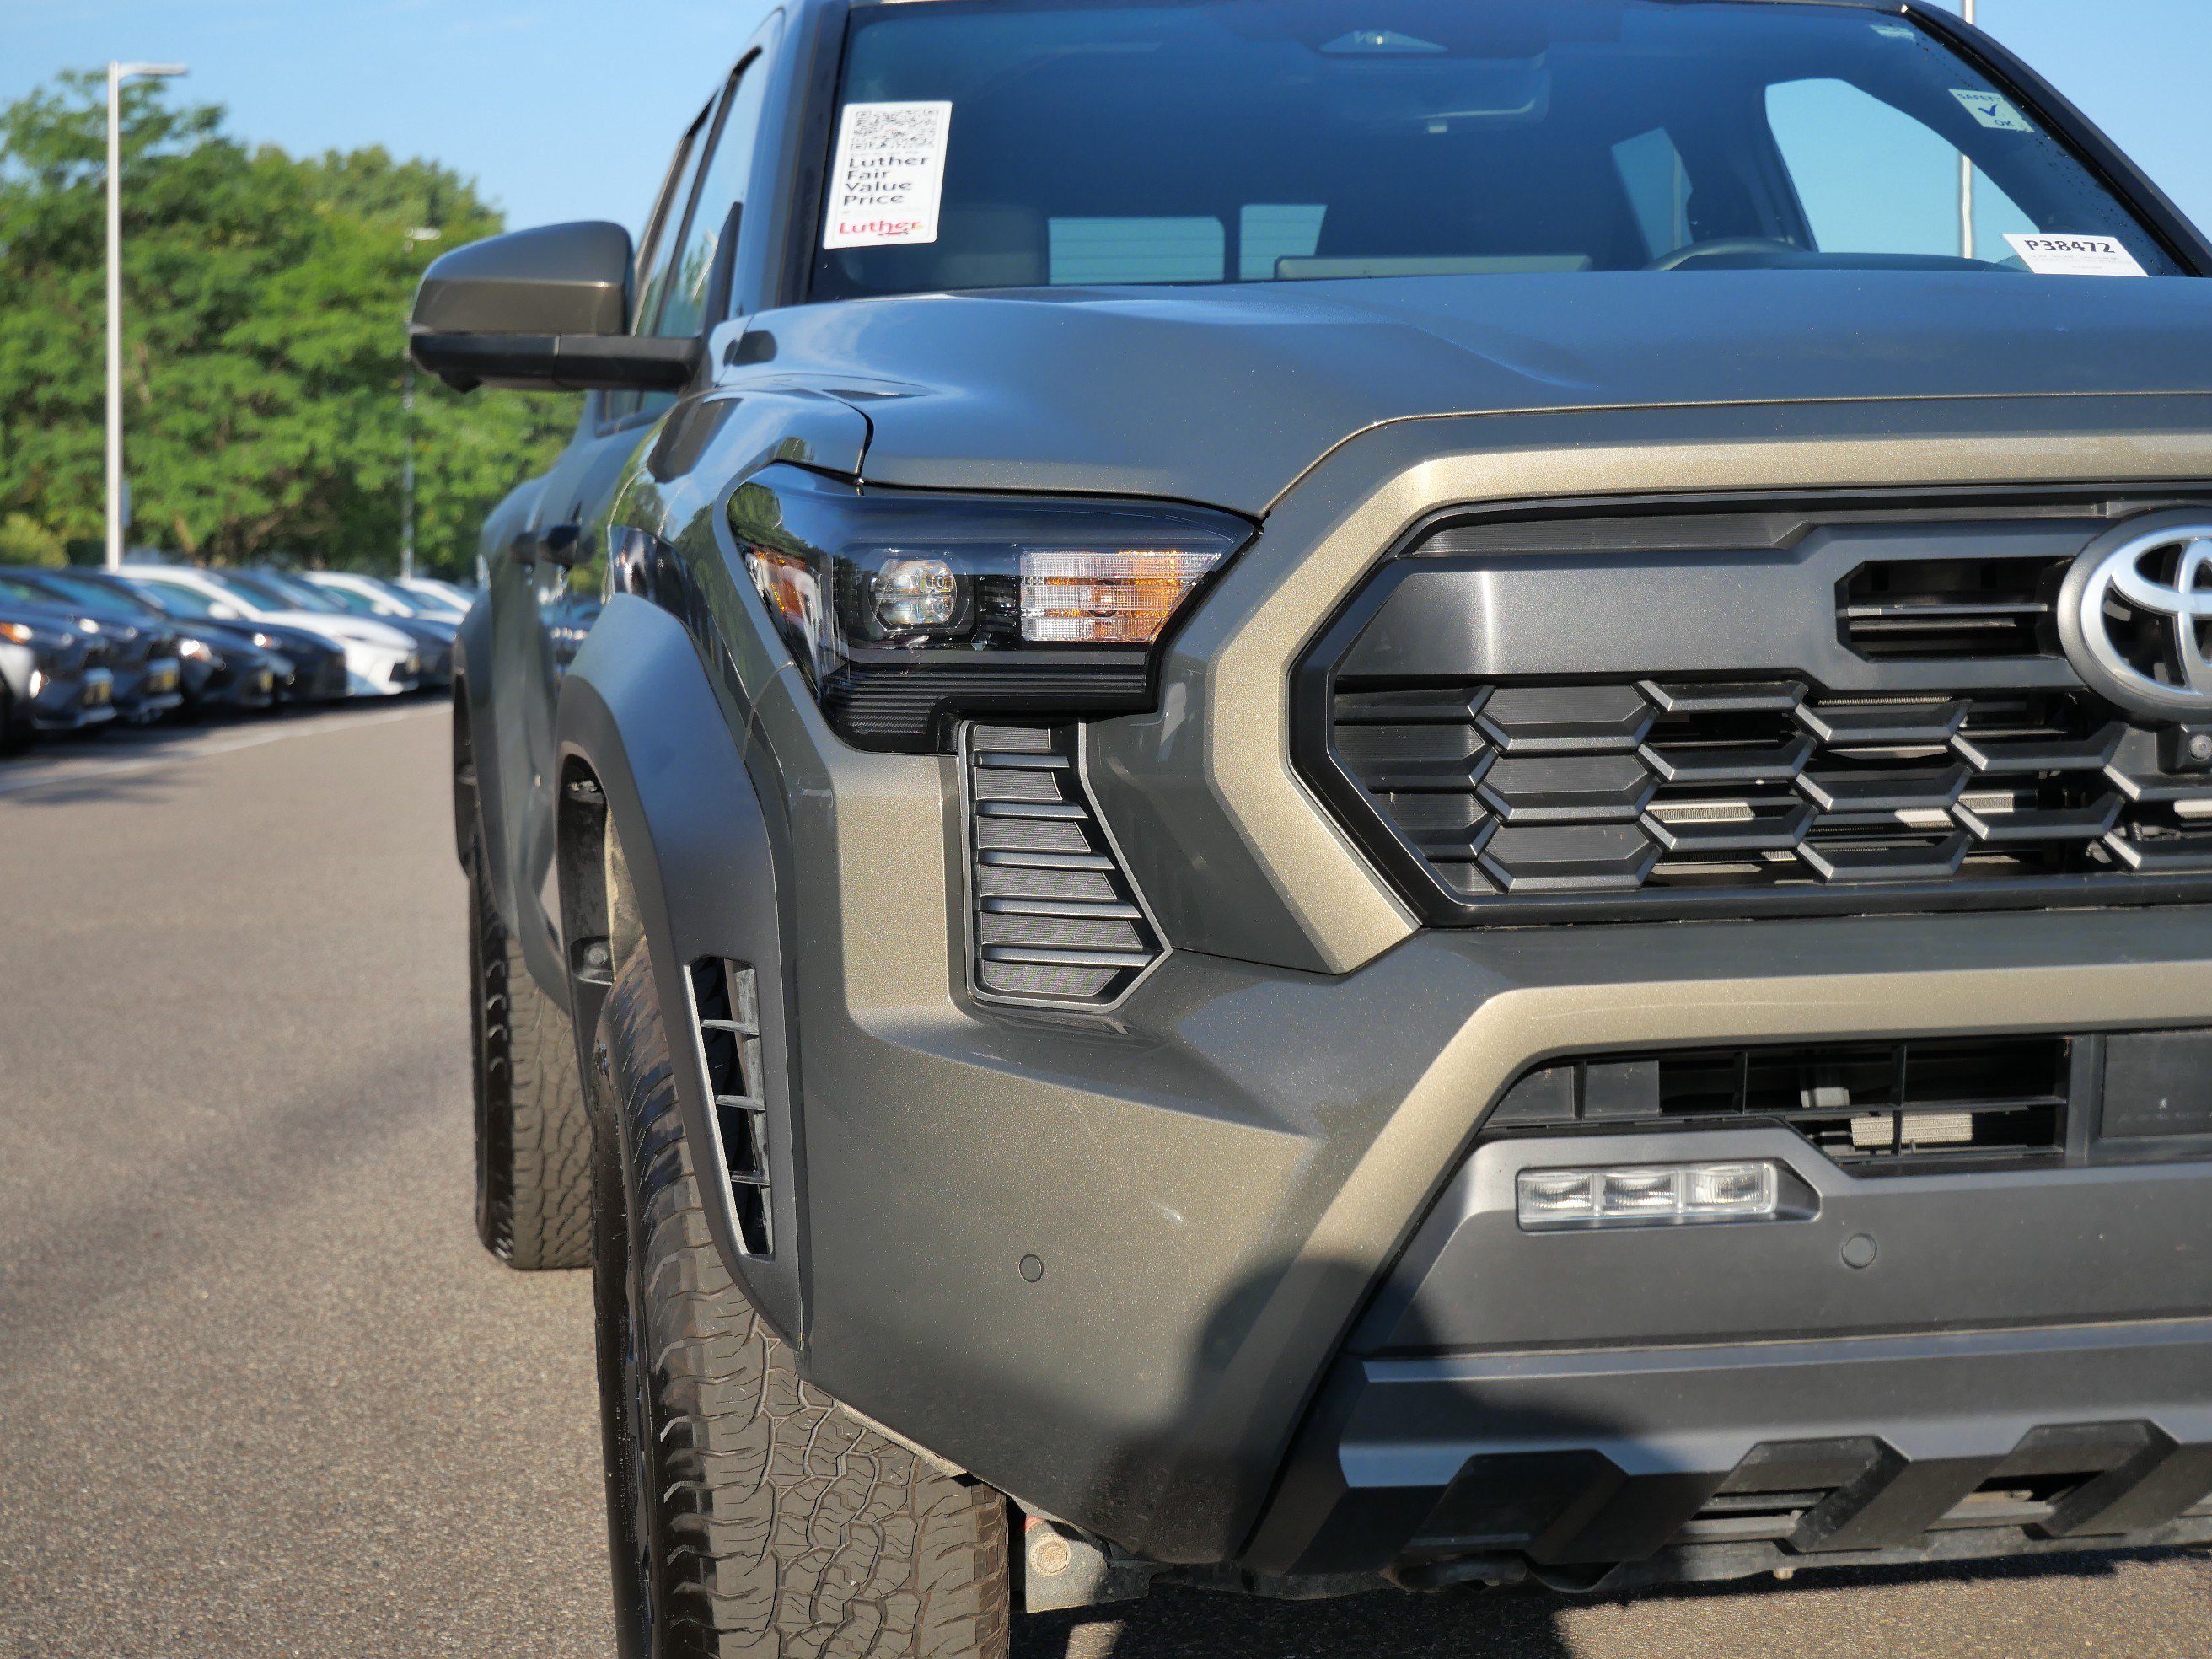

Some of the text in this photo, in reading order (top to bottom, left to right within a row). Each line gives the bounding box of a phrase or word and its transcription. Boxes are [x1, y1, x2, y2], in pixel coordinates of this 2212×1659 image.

[1957, 93, 2004, 103] SAFETY
[1993, 119, 2015, 127] OK
[849, 156, 929, 169] Luther
[847, 169, 889, 180] Fair
[846, 180, 912, 193] Value
[844, 195, 905, 207] Price
[839, 220, 921, 235] Luther
[2024, 239, 2116, 254] P38472
